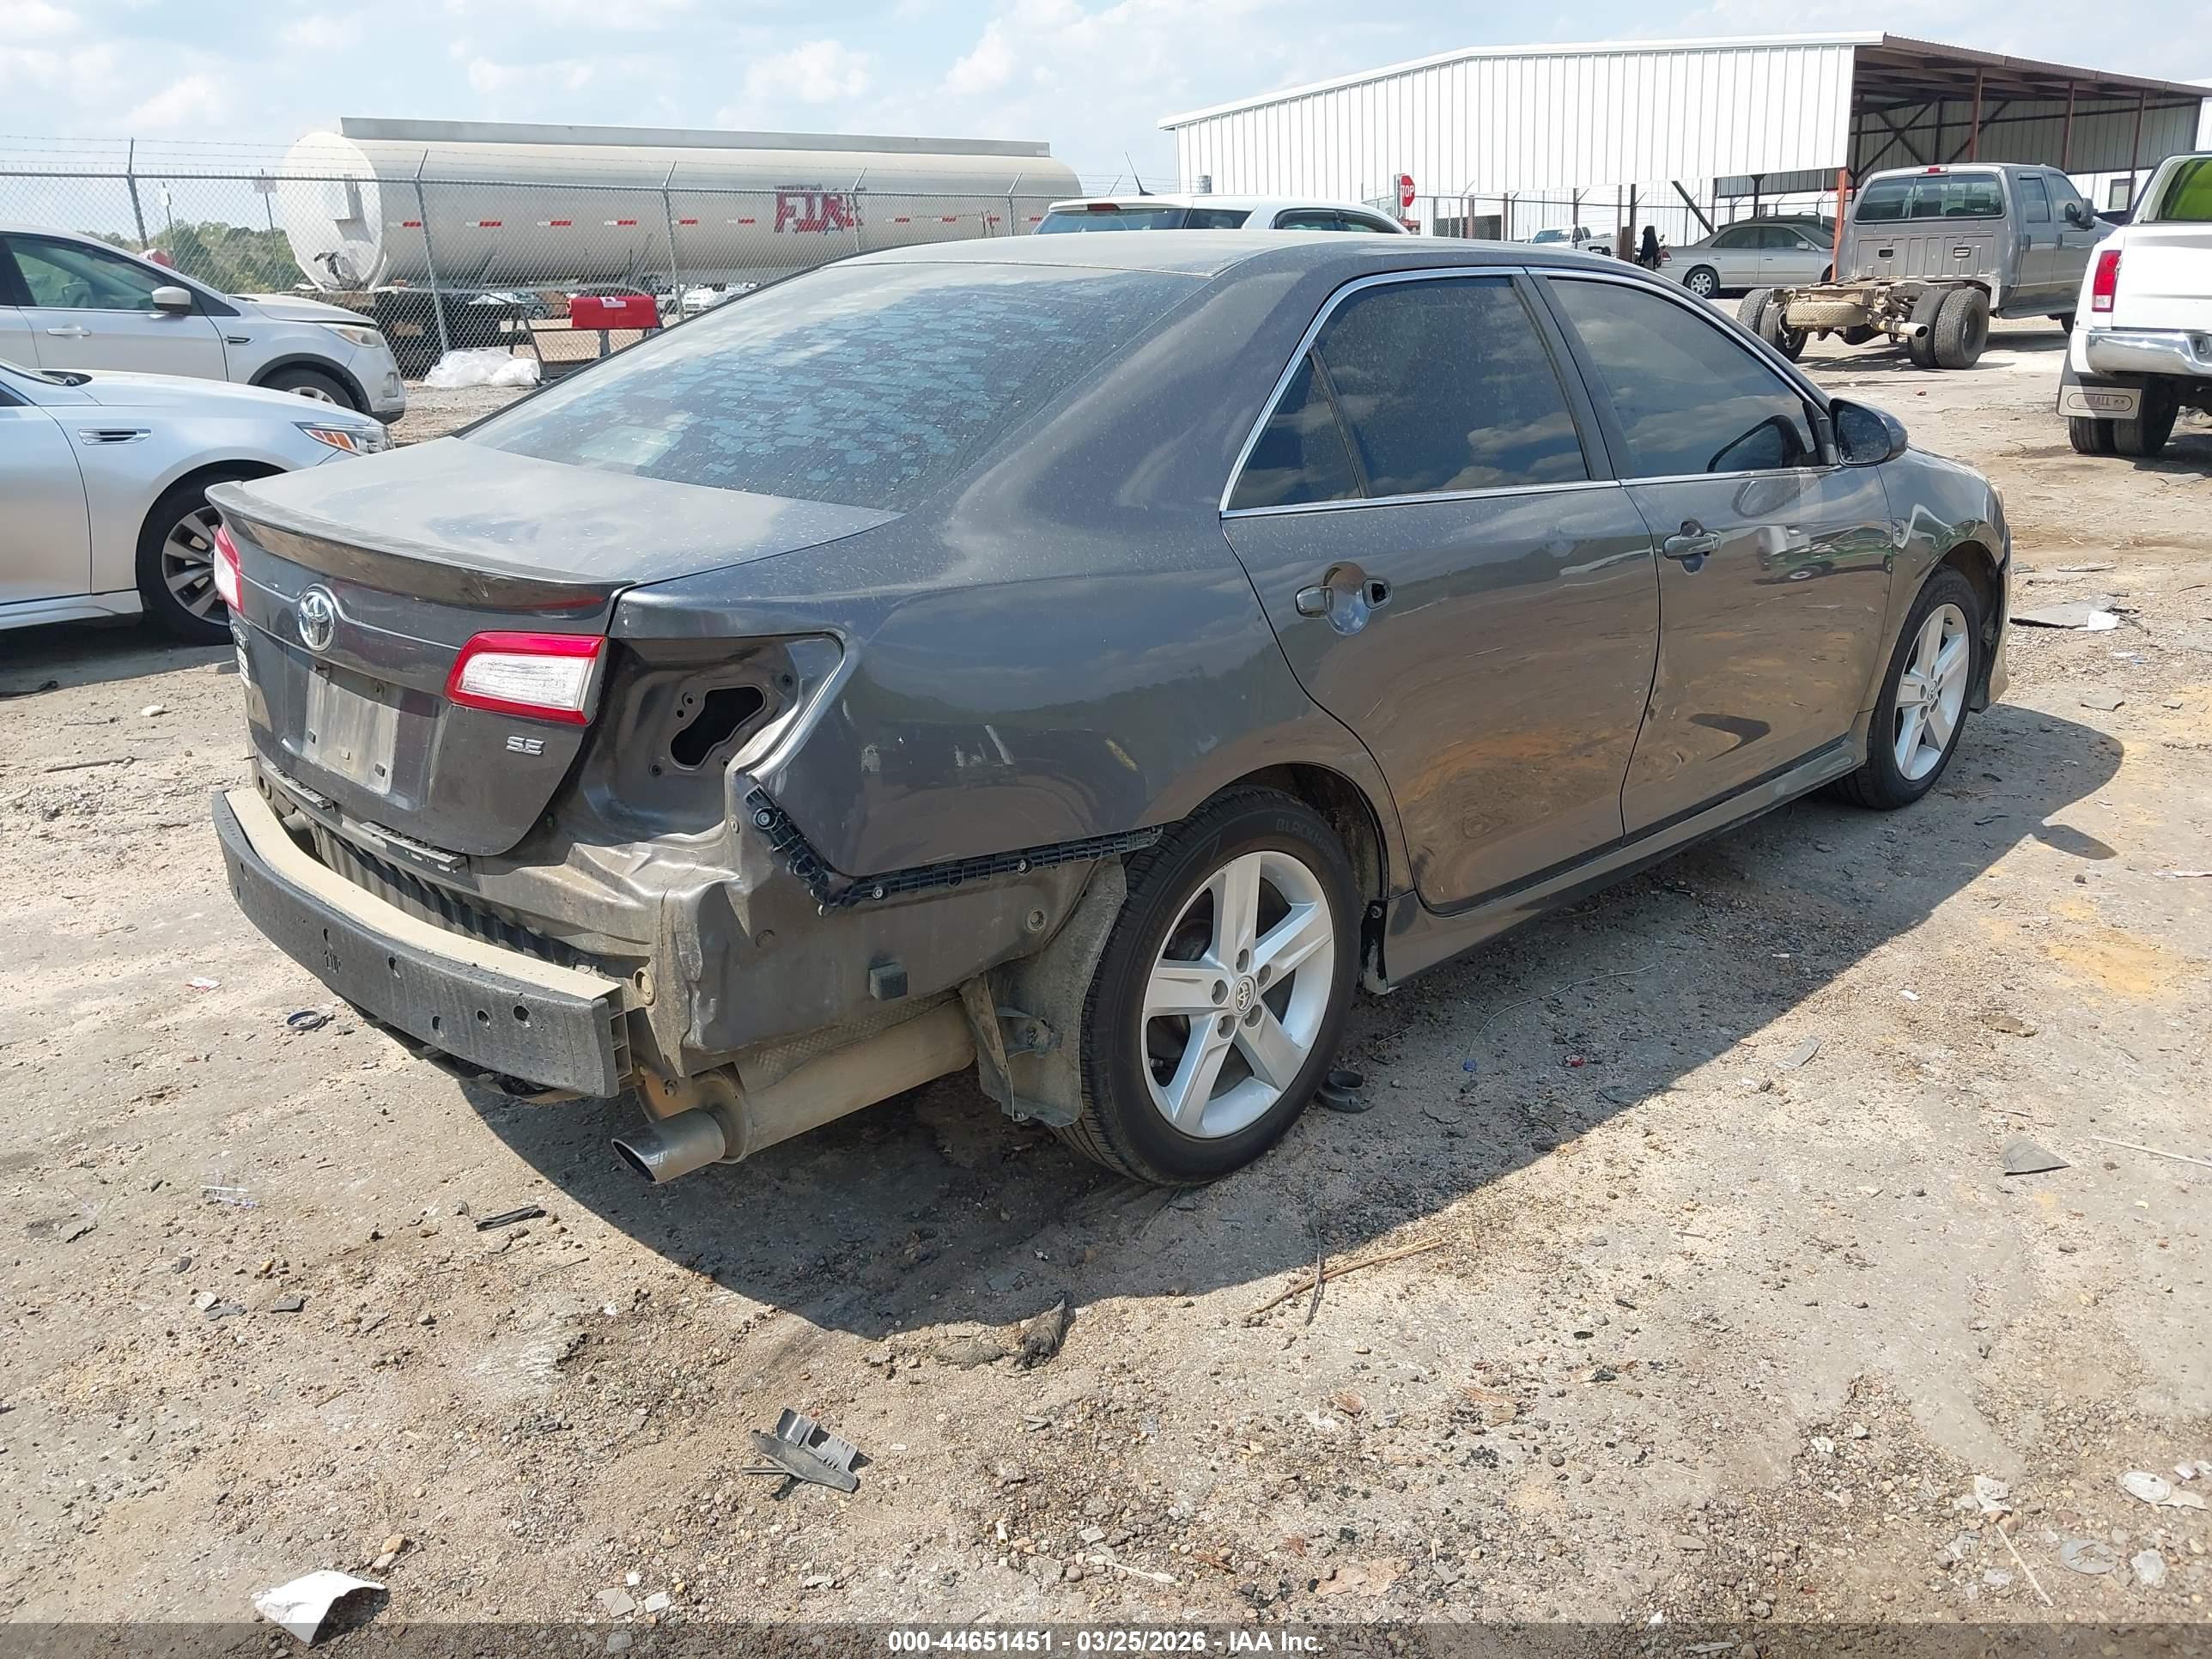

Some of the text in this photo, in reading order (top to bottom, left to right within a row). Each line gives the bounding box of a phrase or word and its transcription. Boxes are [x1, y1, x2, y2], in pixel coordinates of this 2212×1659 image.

[1400, 185, 1415, 198] TOP
[506, 736, 545, 757] SE
[1275, 817, 1341, 867] BLACKHA
